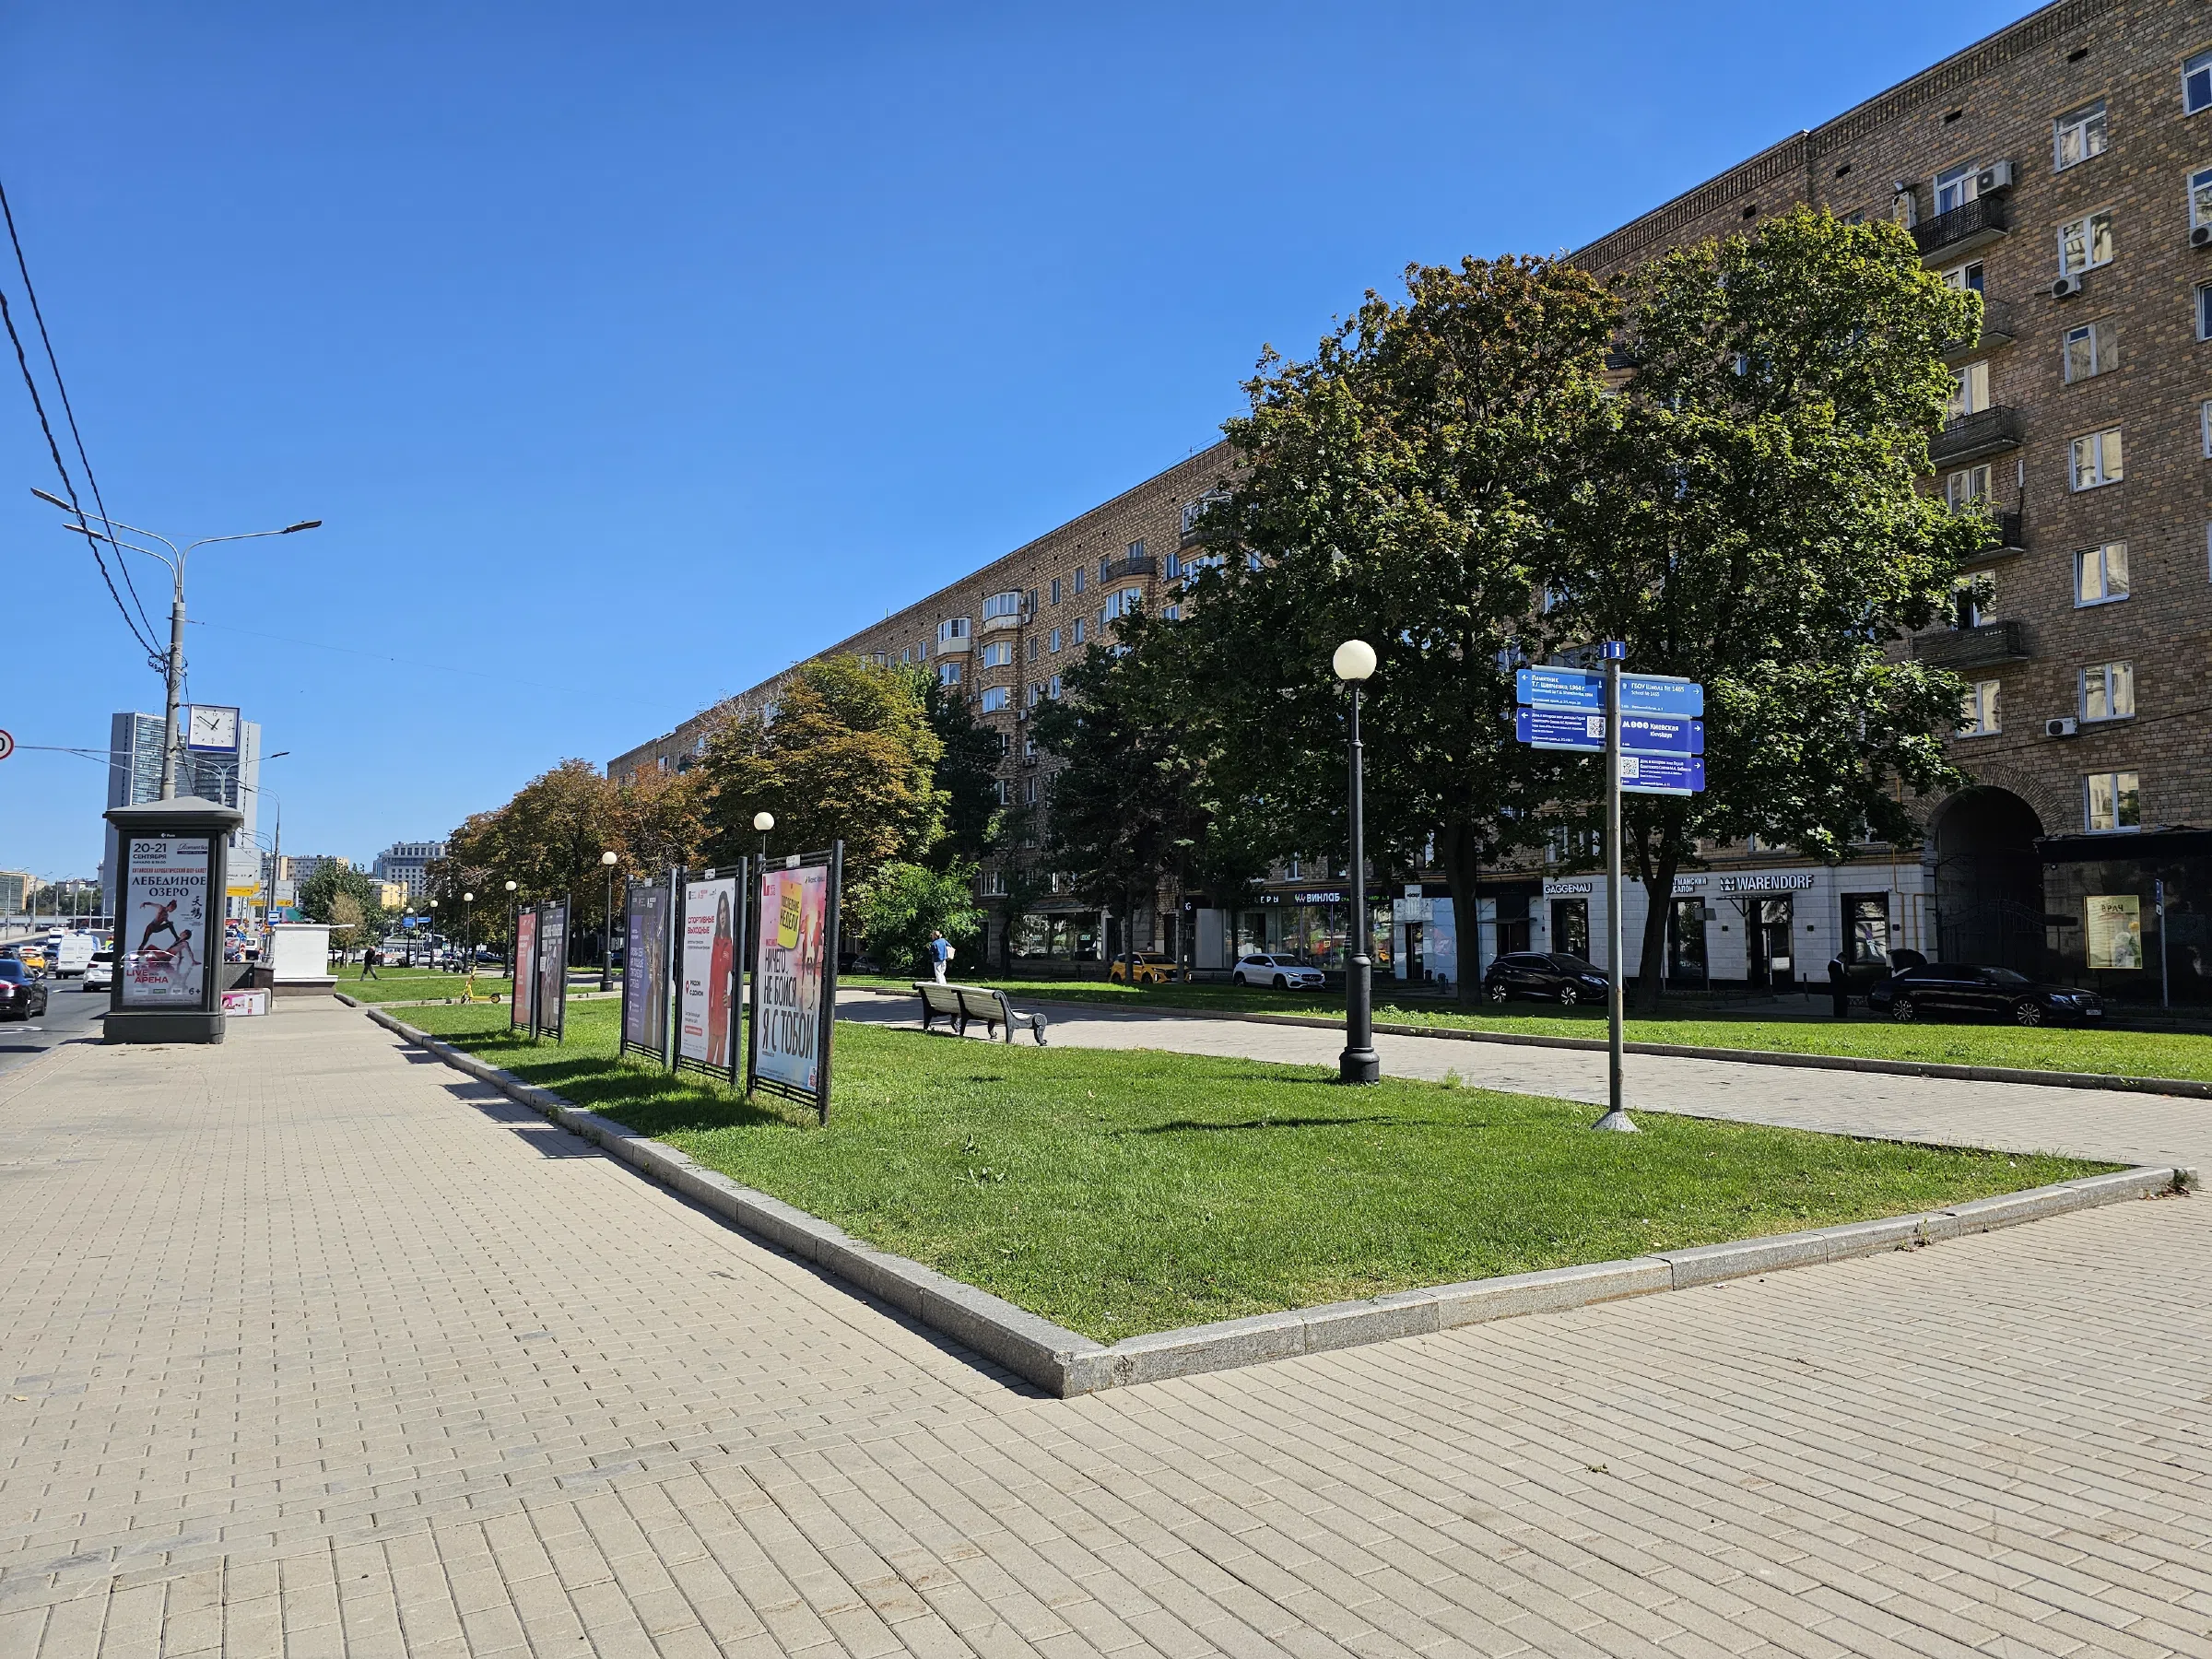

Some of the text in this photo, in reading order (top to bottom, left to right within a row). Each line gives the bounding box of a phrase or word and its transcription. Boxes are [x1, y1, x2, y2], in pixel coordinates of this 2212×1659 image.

[134, 842, 166, 853] 20-21
[132, 877, 206, 886] ЛЕБЕДИНОЕ
[1737, 874, 1814, 890] WARENDORF
[148, 887, 189, 897] ОЗЕРО
[1544, 882, 1592, 895] GAGGENAU
[1673, 885, 1694, 893] САЛОН
[688, 915, 714, 924] СПОРТИВНЫЕ
[780, 908, 799, 932] НЕДЕЛИ
[688, 926, 710, 935] ВЫХОДНЫЕ
[765, 947, 786, 973] НИЧЕГО
[188, 987, 201, 995] 6+
[763, 975, 772, 1005] НЕ
[762, 1008, 770, 1050] Я
[771, 1008, 779, 1053] С
